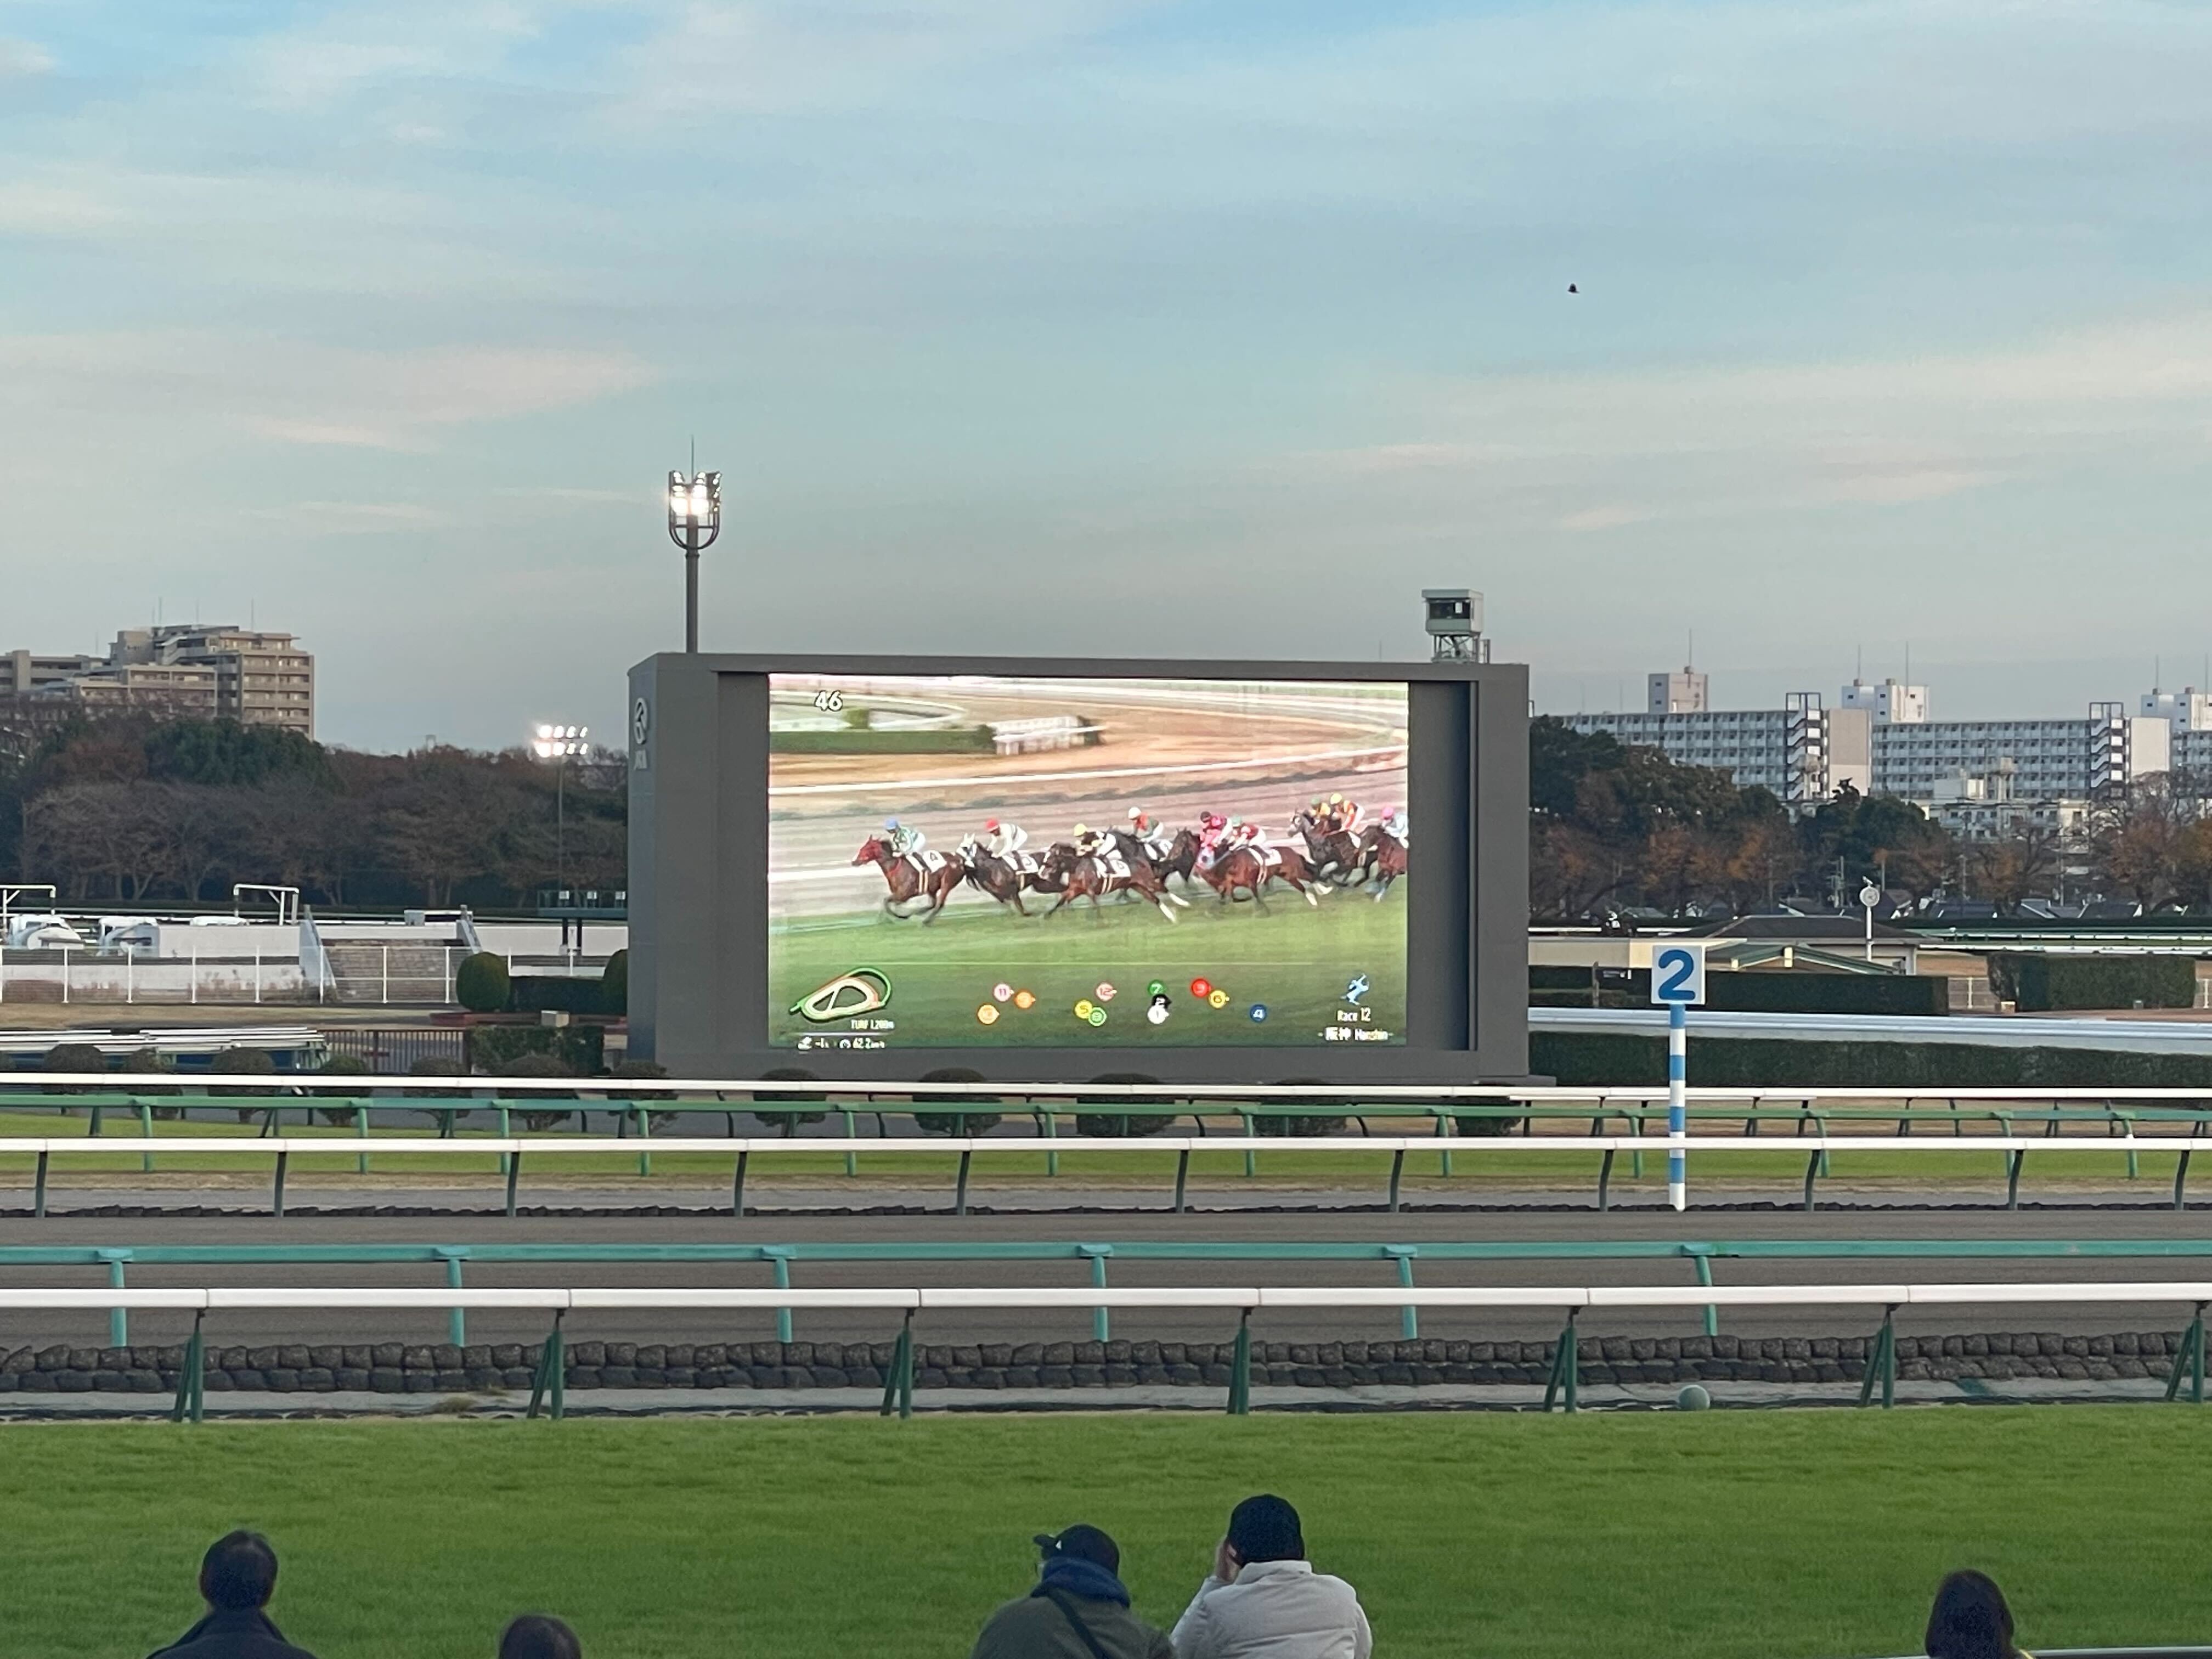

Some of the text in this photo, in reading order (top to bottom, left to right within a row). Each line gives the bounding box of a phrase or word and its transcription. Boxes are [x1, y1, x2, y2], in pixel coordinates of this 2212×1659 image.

[814, 690, 843, 712] 46
[1658, 949, 1696, 1000] 2
[1360, 1007, 1371, 1021] 12
